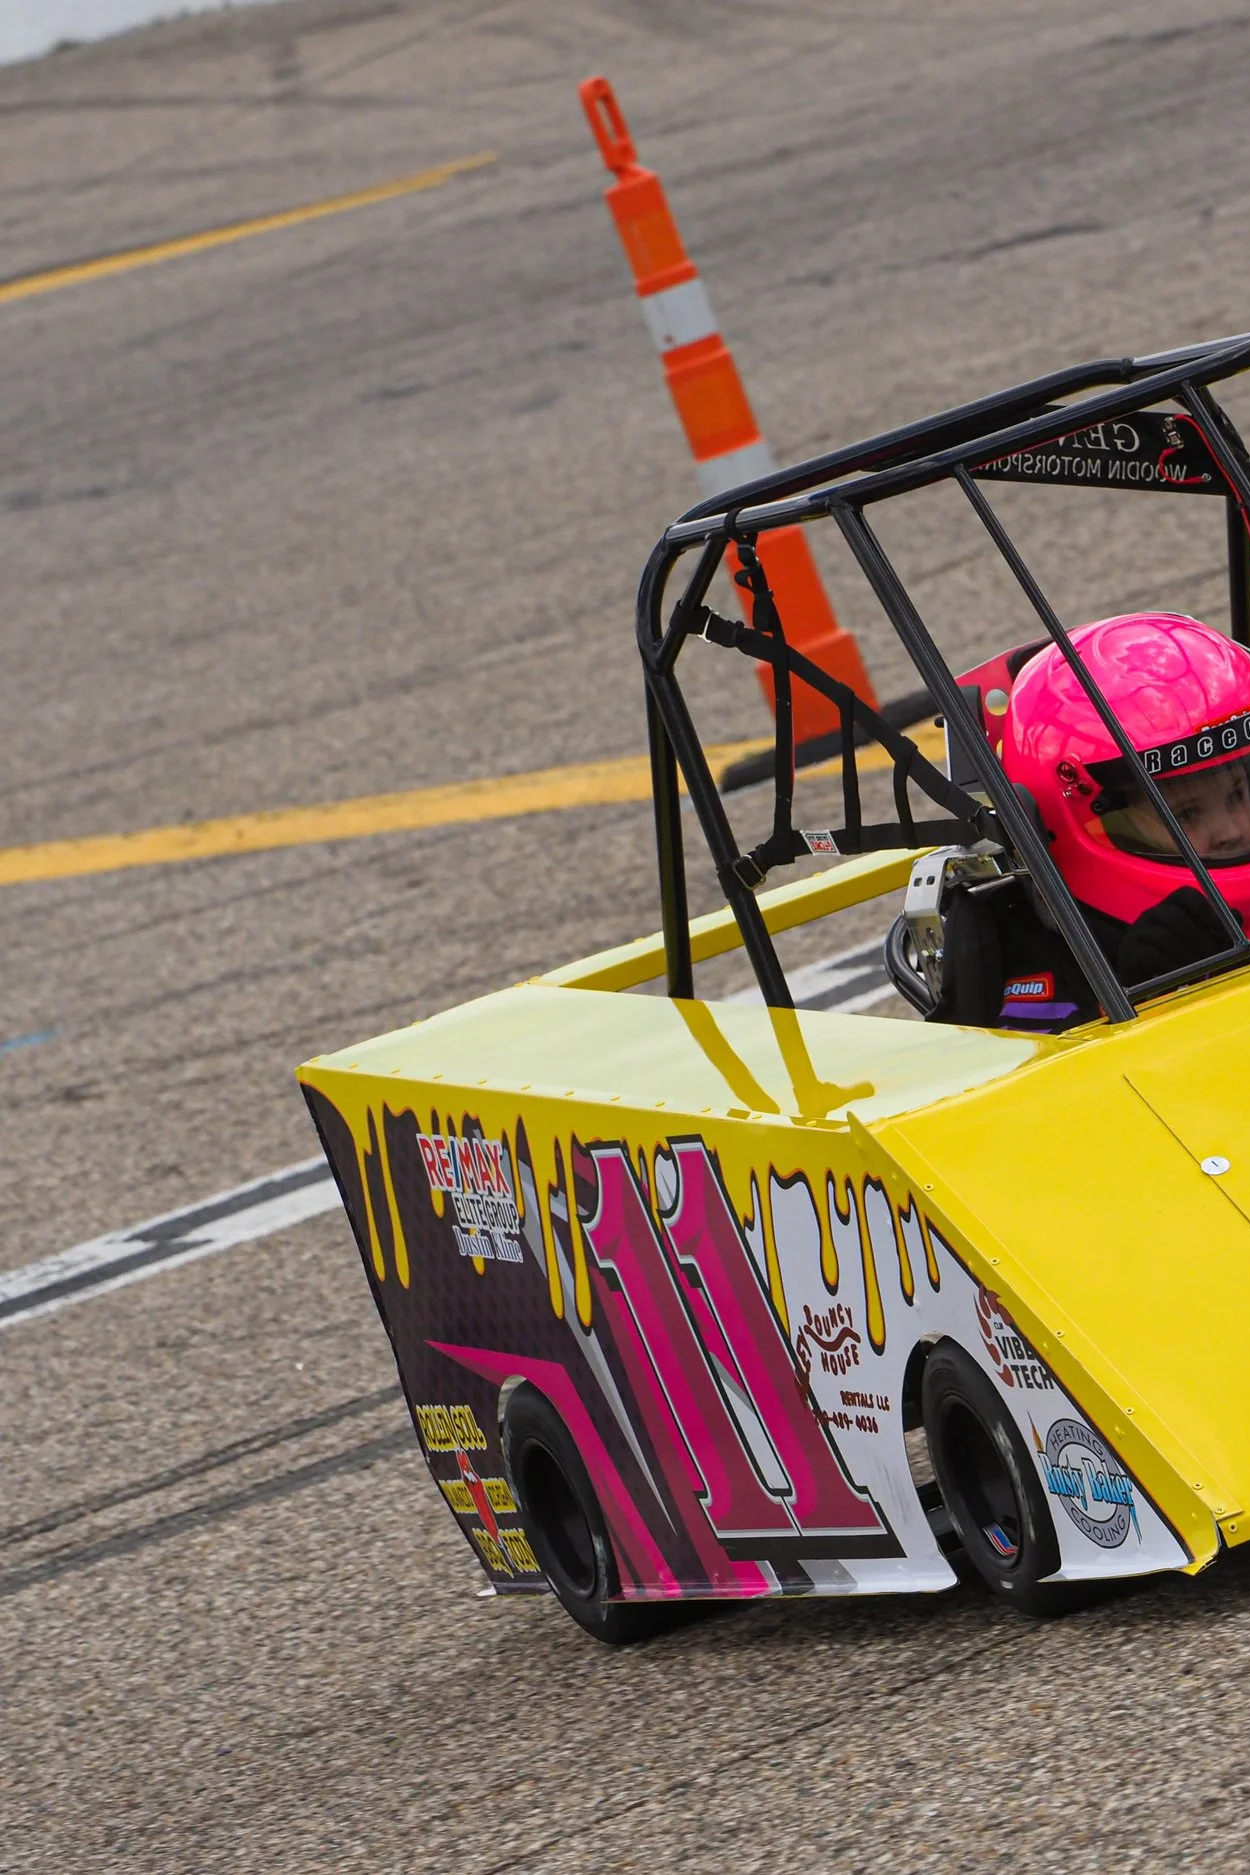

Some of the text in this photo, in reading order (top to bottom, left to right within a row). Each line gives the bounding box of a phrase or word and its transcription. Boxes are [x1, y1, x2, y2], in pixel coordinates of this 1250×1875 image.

[416, 1136, 511, 1197] RE/MAX
[453, 1194, 520, 1233] ELITE GROUP
[803, 1302, 854, 1338] BOUNCY
[580, 1136, 890, 1541] 11
[820, 1343, 860, 1376] HOUSE
[1010, 1364, 1055, 1390] TECH
[839, 1389, 890, 1412] RENTALS LLC
[1050, 1425, 1104, 1456] HEATING
[1071, 1506, 1126, 1542] COOLING
